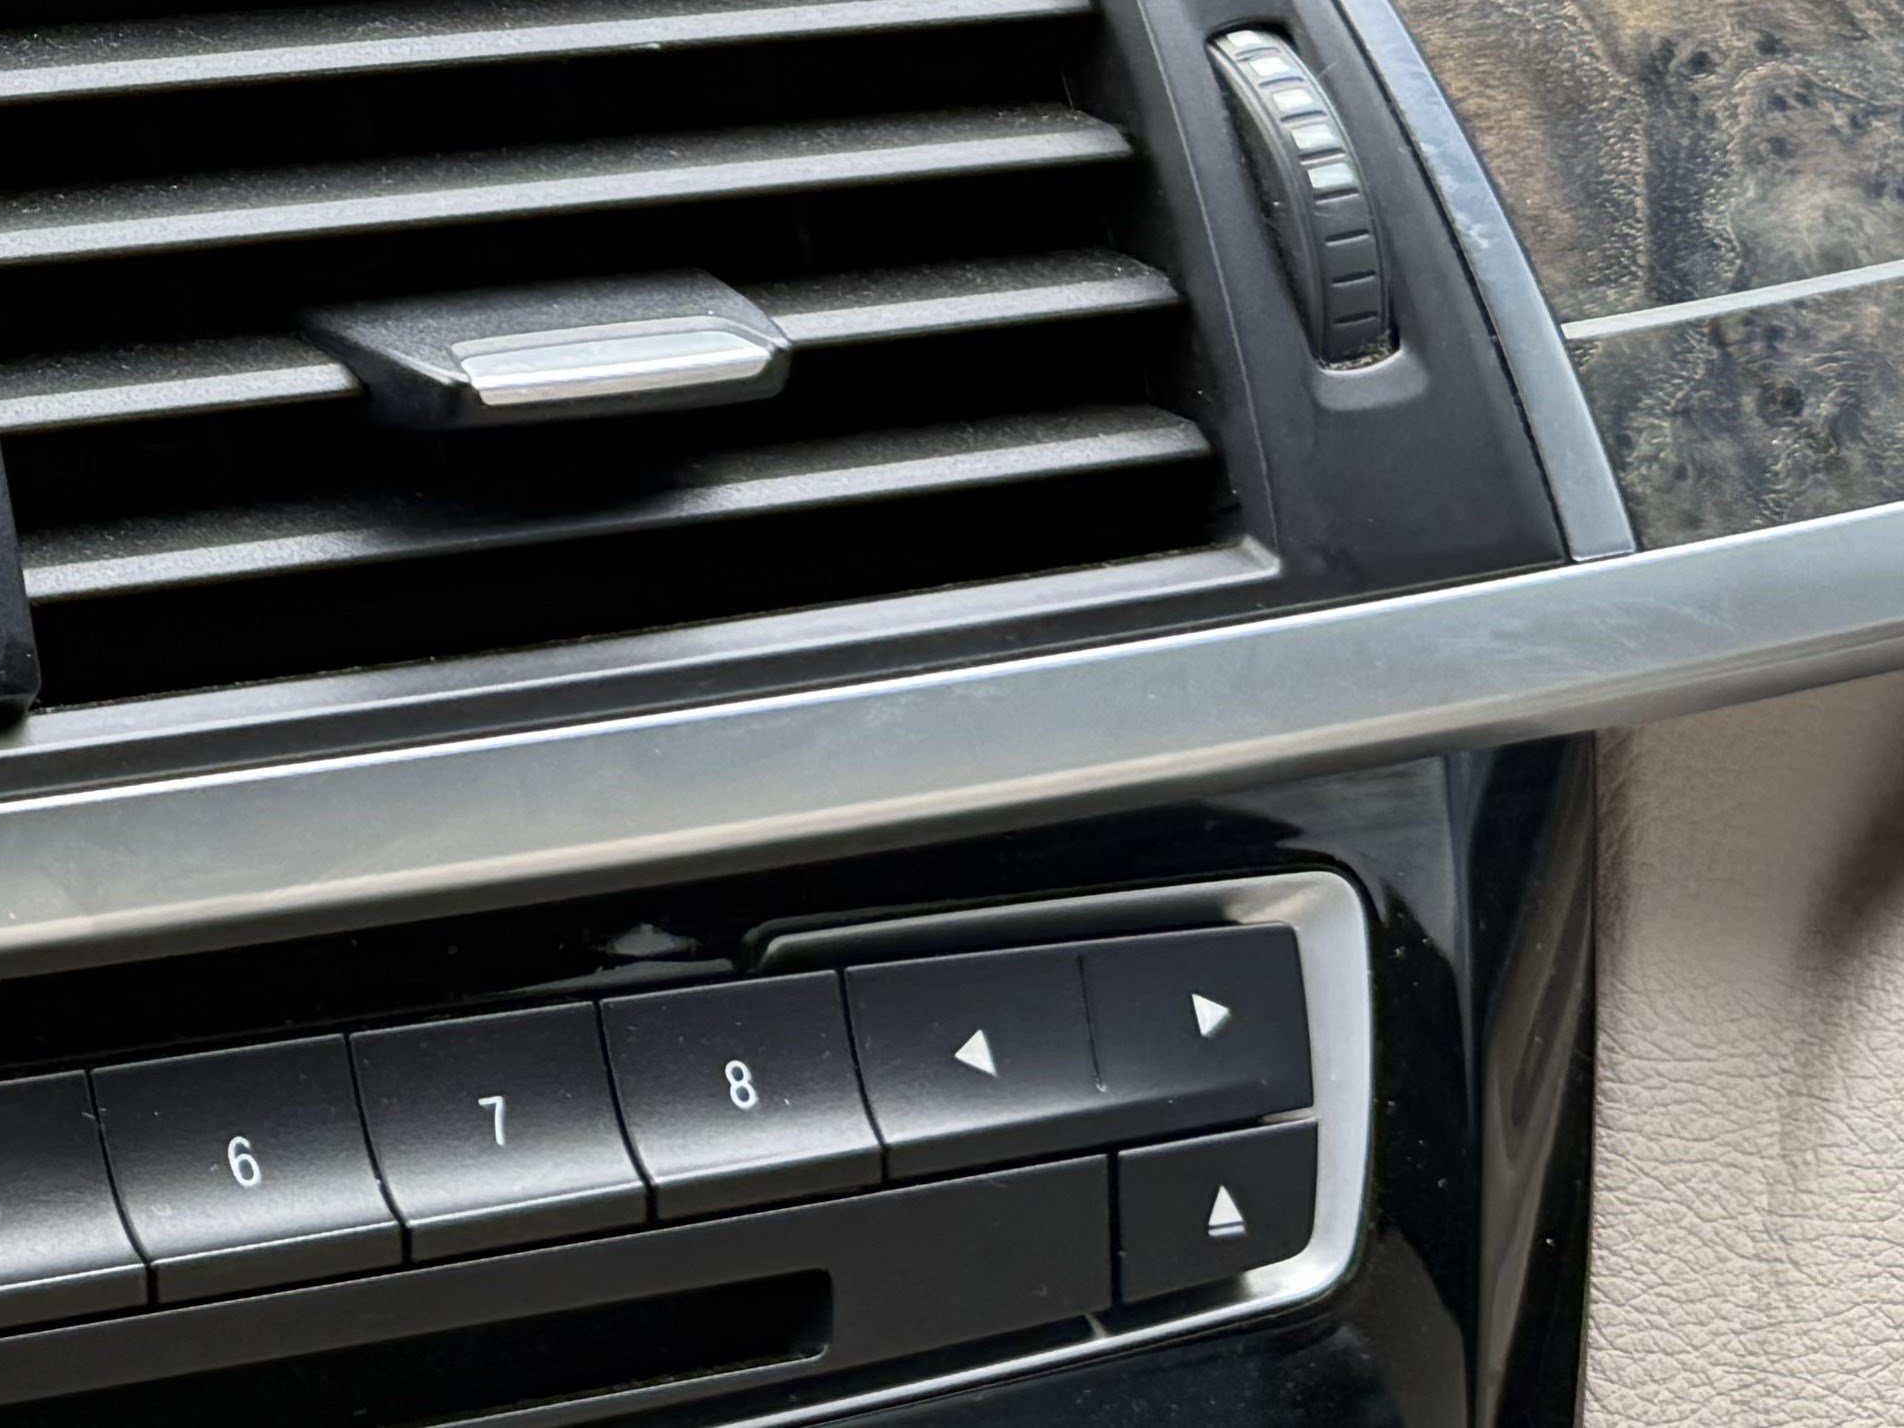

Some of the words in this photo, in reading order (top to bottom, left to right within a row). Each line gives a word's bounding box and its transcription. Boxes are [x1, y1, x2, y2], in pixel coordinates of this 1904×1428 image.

[723, 1059, 760, 1112] 8
[477, 1094, 508, 1148] 7
[225, 1134, 263, 1189] 6
